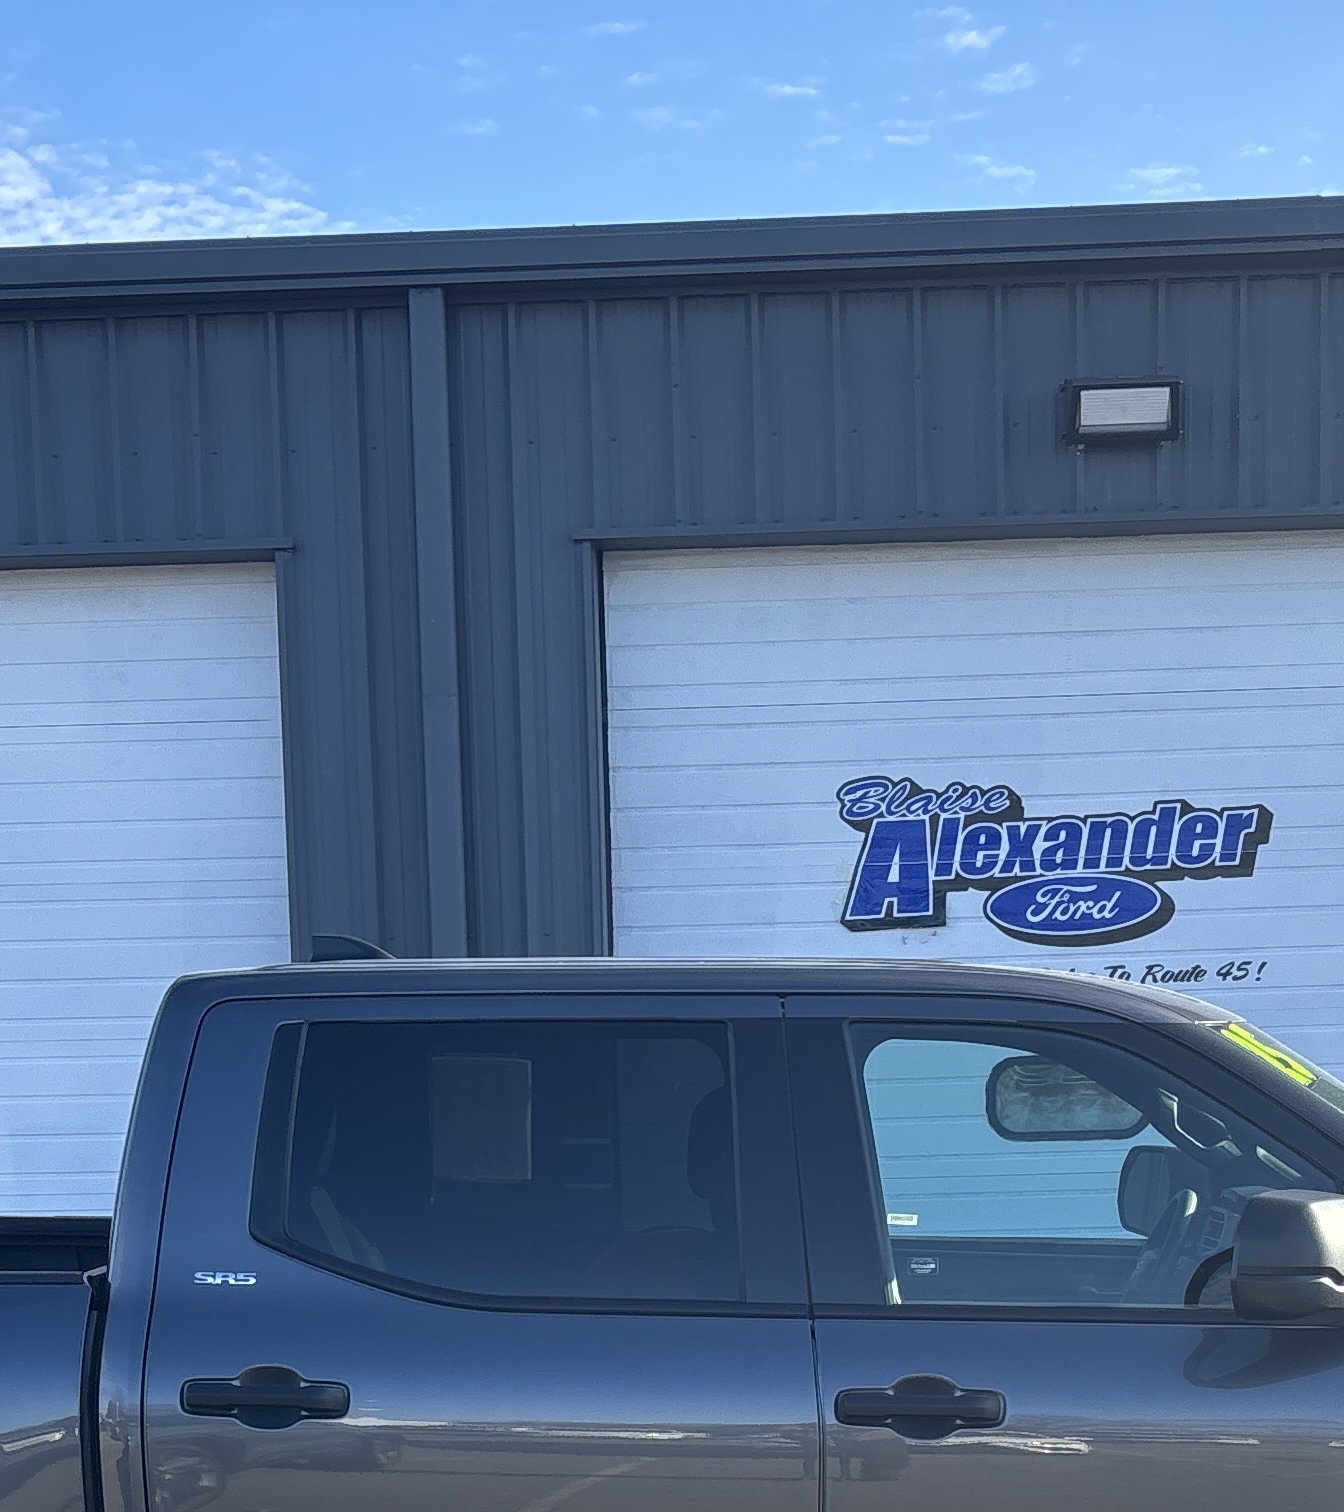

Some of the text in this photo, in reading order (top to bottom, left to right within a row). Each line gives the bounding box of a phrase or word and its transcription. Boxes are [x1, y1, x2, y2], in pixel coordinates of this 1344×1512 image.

[839, 778, 1012, 821] Blaise
[844, 802, 1260, 921] Alexander
[1025, 884, 1122, 923] Ford
[1140, 964, 1208, 984] Route
[1216, 961, 1268, 982] 45!
[193, 1271, 257, 1285] SR5
